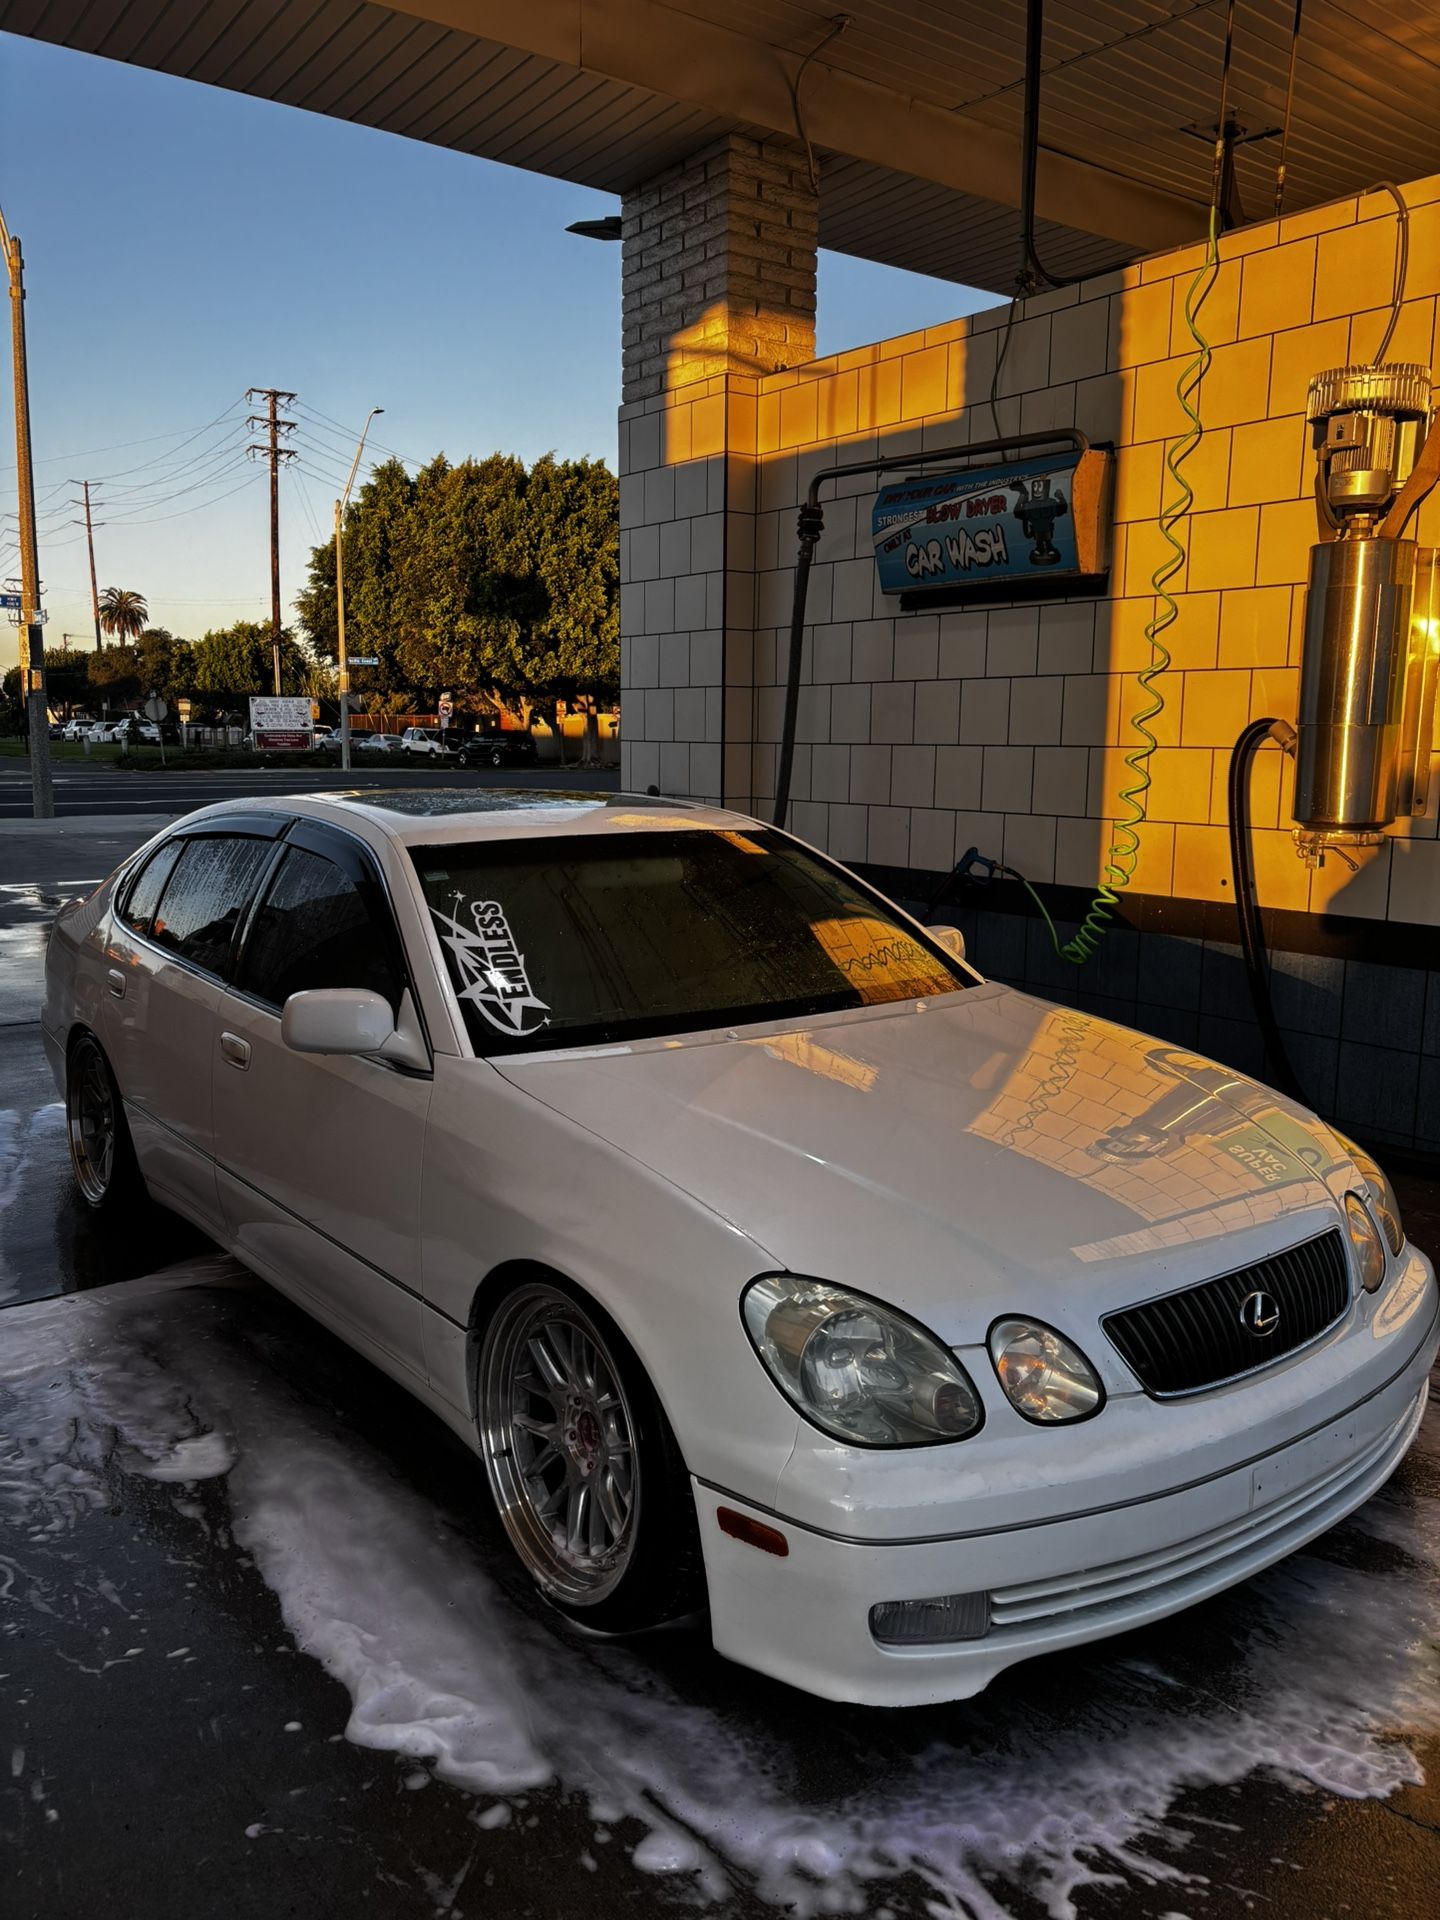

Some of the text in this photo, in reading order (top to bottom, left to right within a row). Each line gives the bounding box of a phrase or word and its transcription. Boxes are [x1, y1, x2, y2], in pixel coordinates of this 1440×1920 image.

[876, 495, 1007, 527] STRONGEST BLOW DRYER
[905, 523, 1009, 578] CAR WASH
[472, 902, 532, 1001] ENDLESS
